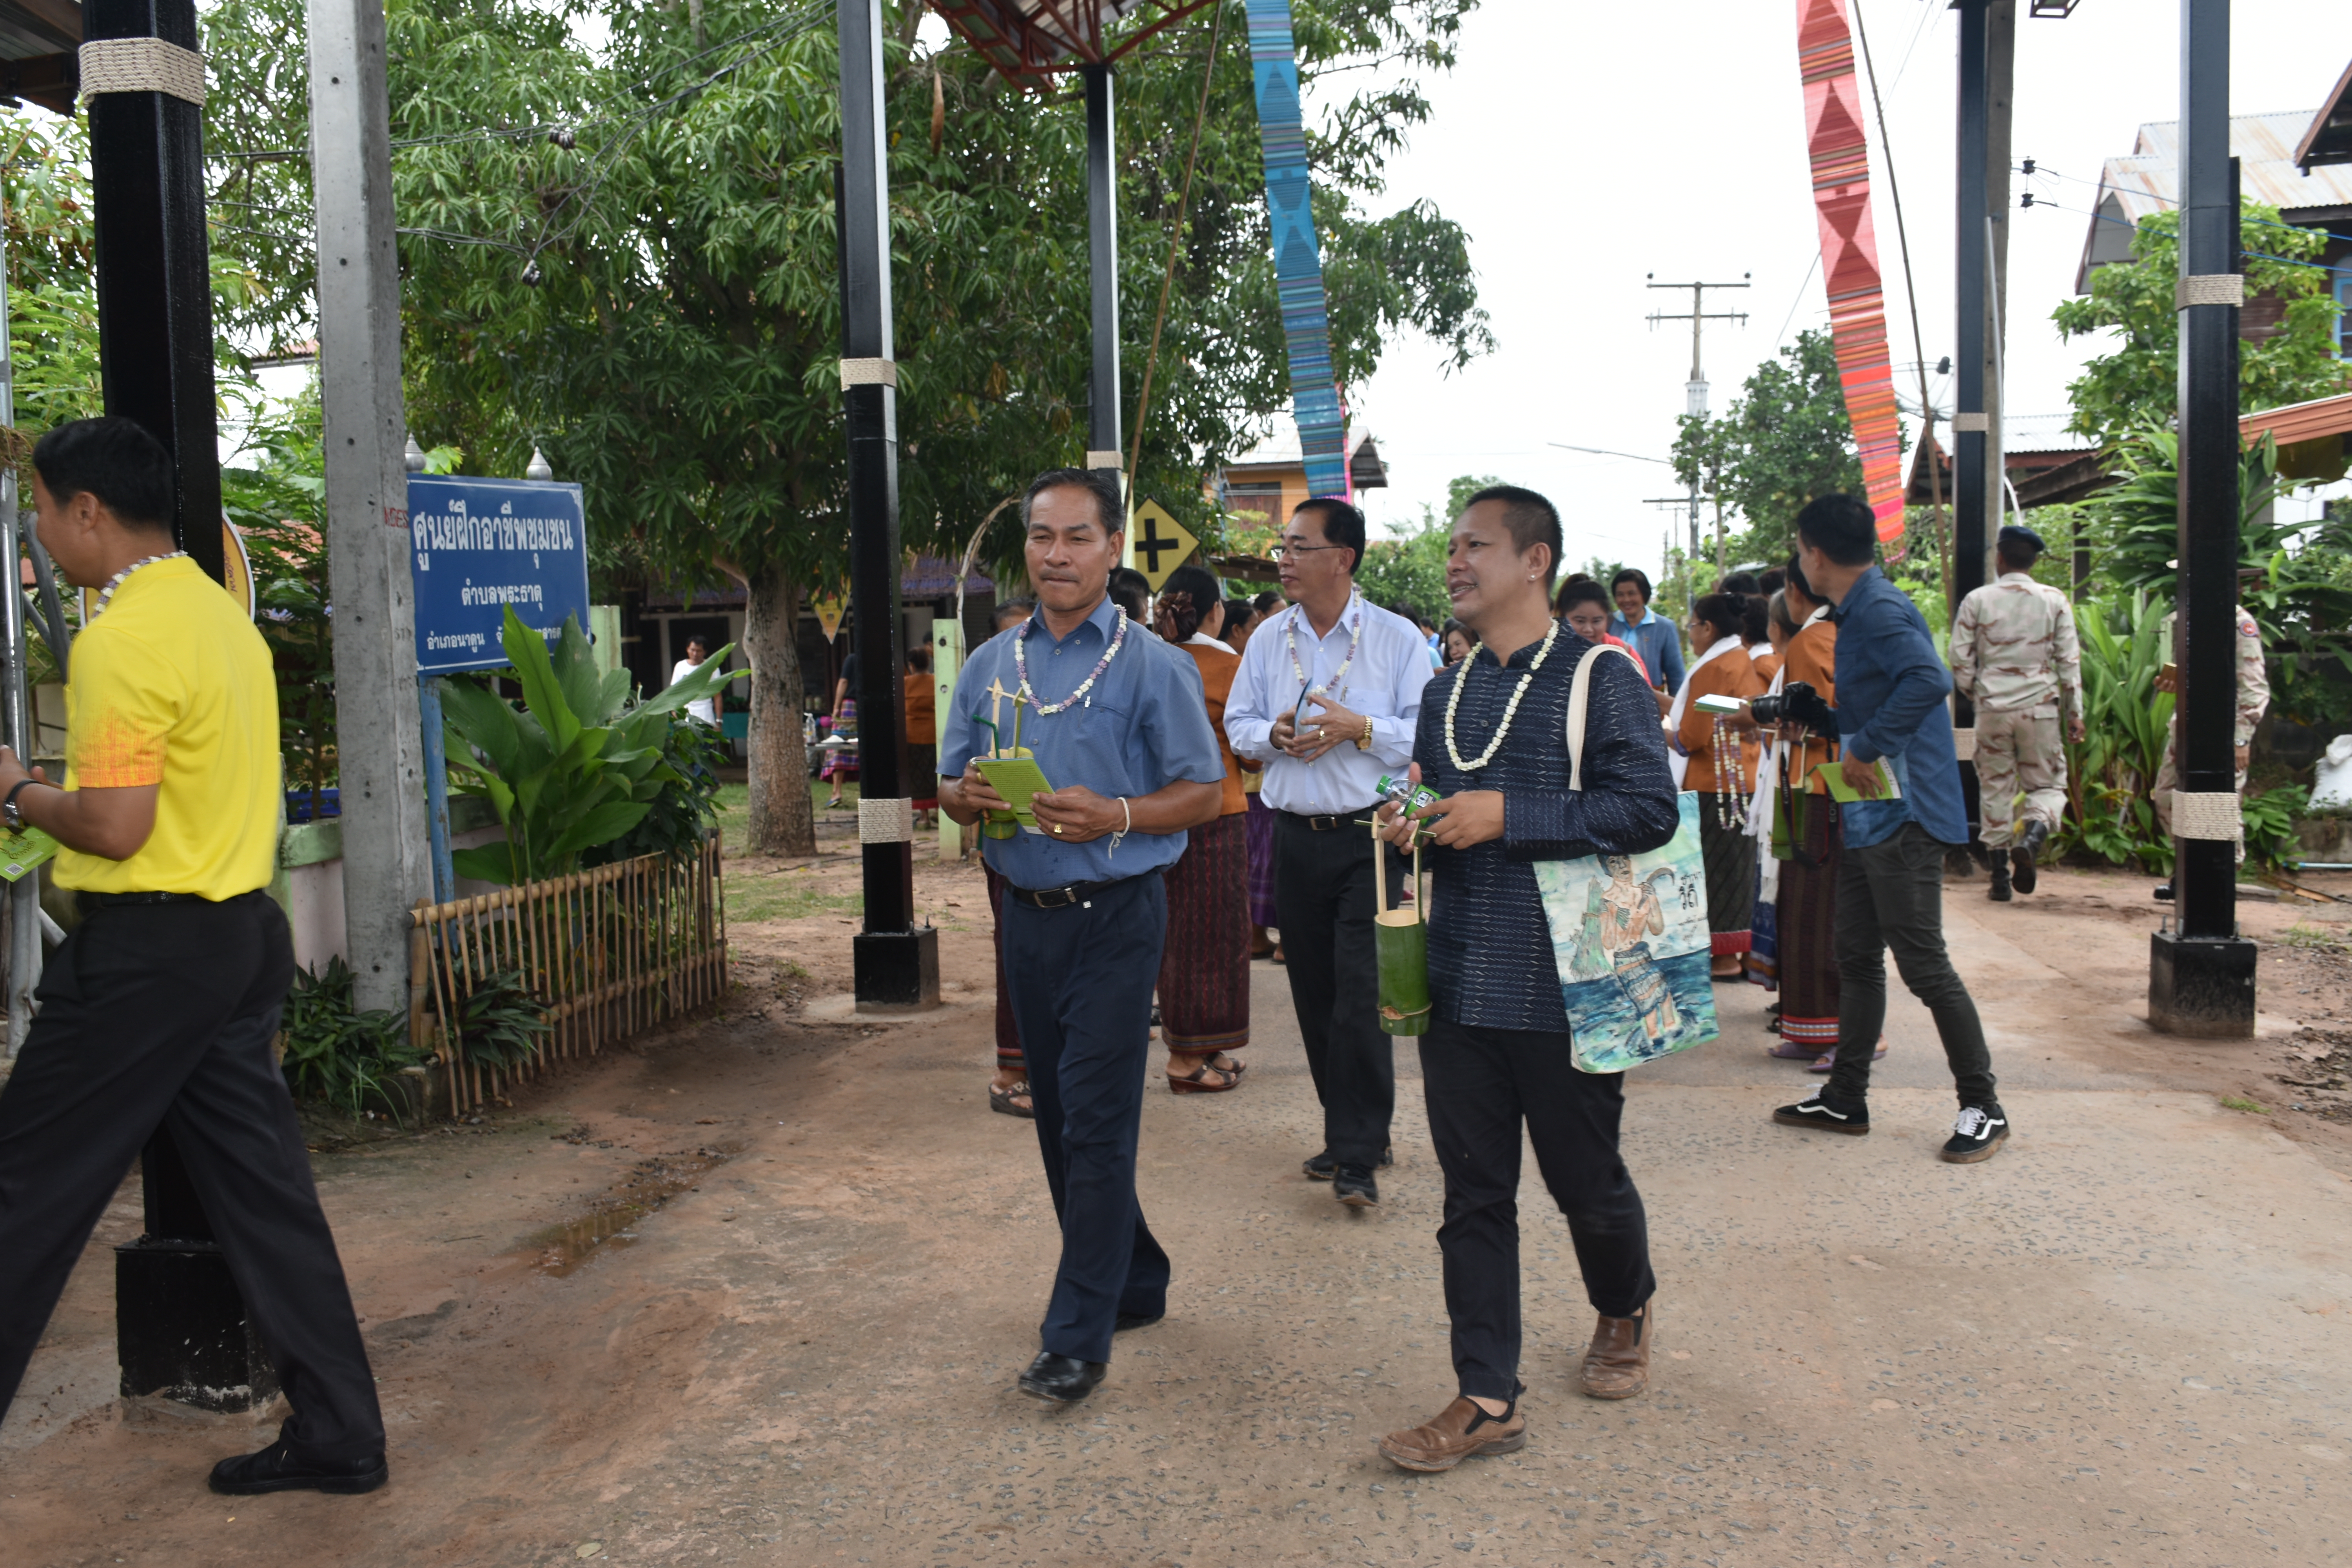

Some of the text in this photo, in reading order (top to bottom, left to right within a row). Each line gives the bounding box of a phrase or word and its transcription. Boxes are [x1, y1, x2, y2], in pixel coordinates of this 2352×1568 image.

[414, 499, 574, 571] ศูนย์ฝึกอาชีพชุมชน
[461, 577, 543, 612] ตำบลพระธาตุ
[426, 630, 485, 653] อำเภอนาดูน
